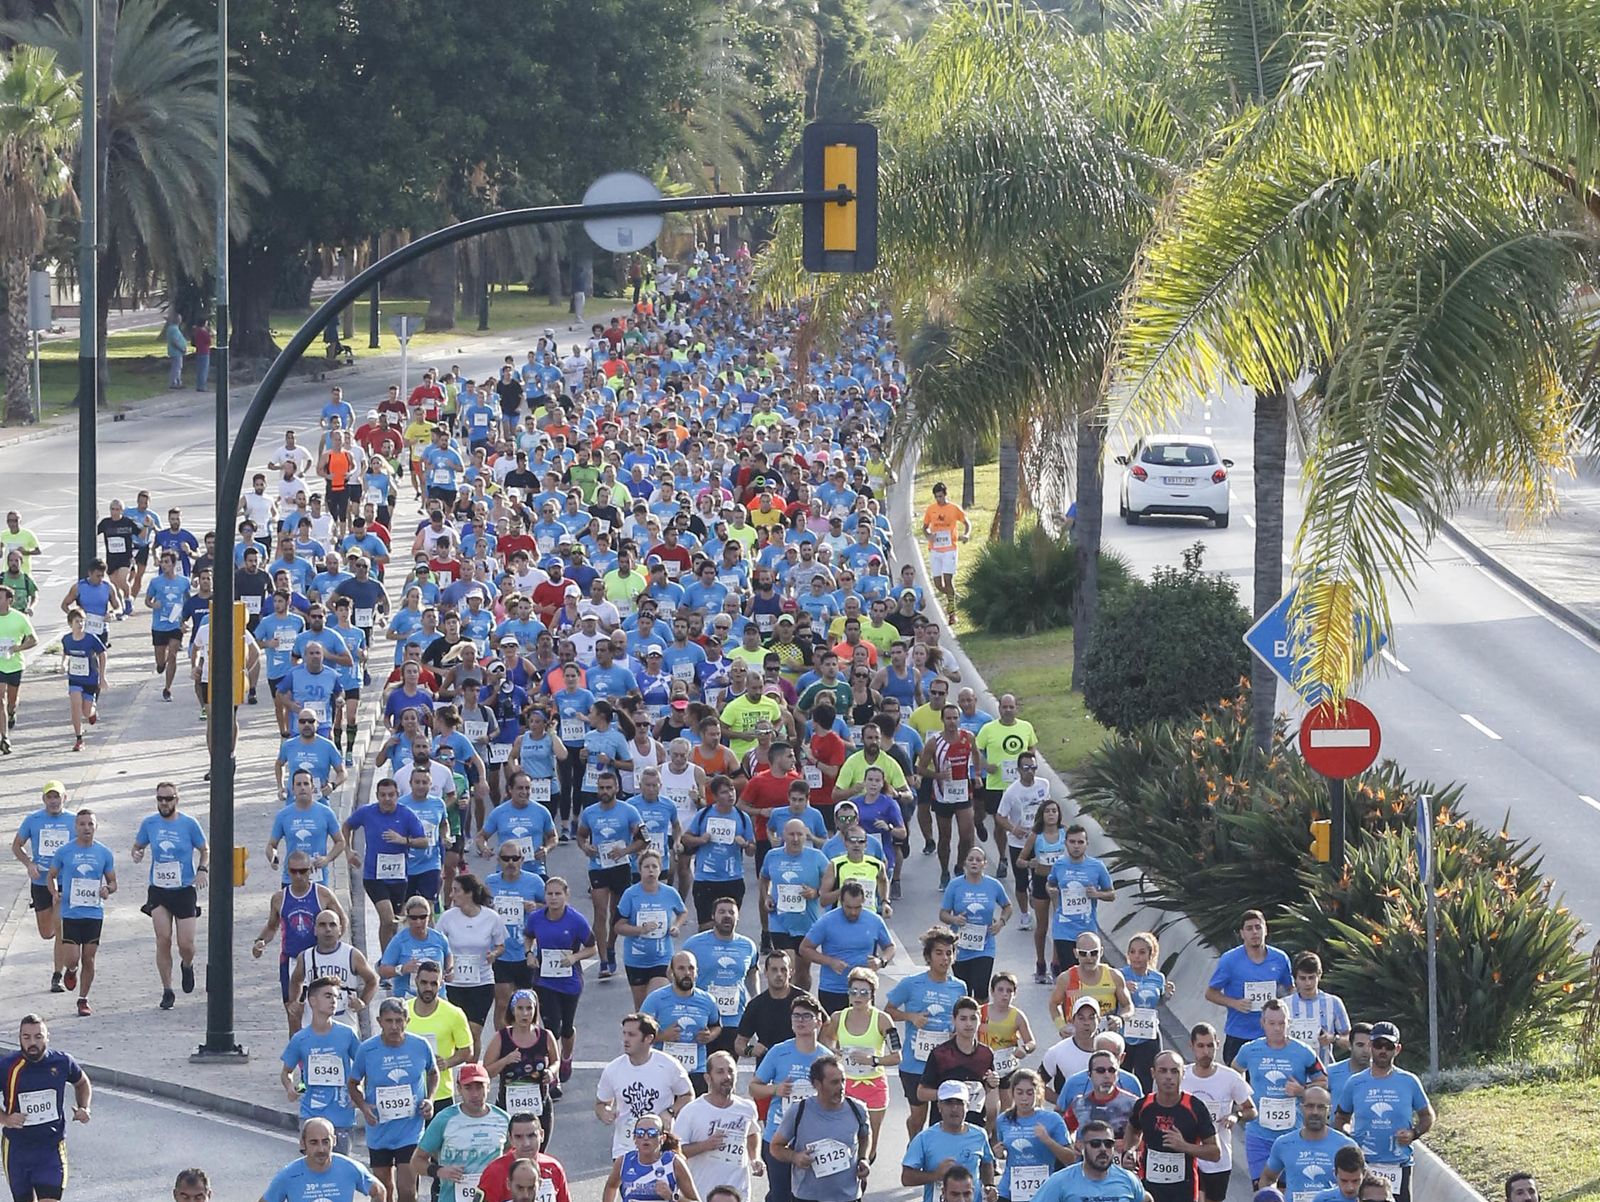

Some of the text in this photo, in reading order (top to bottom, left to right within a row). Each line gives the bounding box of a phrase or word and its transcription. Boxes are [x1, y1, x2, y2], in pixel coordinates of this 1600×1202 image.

[711, 828, 731, 836] 9320
[156, 872, 177, 880] 3852
[76, 889, 97, 897] 3604
[1067, 897, 1087, 907] 2820
[498, 908, 519, 916] 6419
[1250, 992, 1271, 1002] 3516
[1128, 1019, 1155, 1031] 15654
[996, 1058, 1018, 1071] 3503
[314, 1067, 338, 1075] 6349
[26, 1101, 51, 1114] 6080
[380, 1097, 411, 1110] 15392
[510, 1098, 540, 1109] 18483
[1266, 1110, 1290, 1120] 1525
[815, 1148, 846, 1166] 15125
[1152, 1162, 1179, 1174] 2908
[1015, 1179, 1044, 1190] 1373
